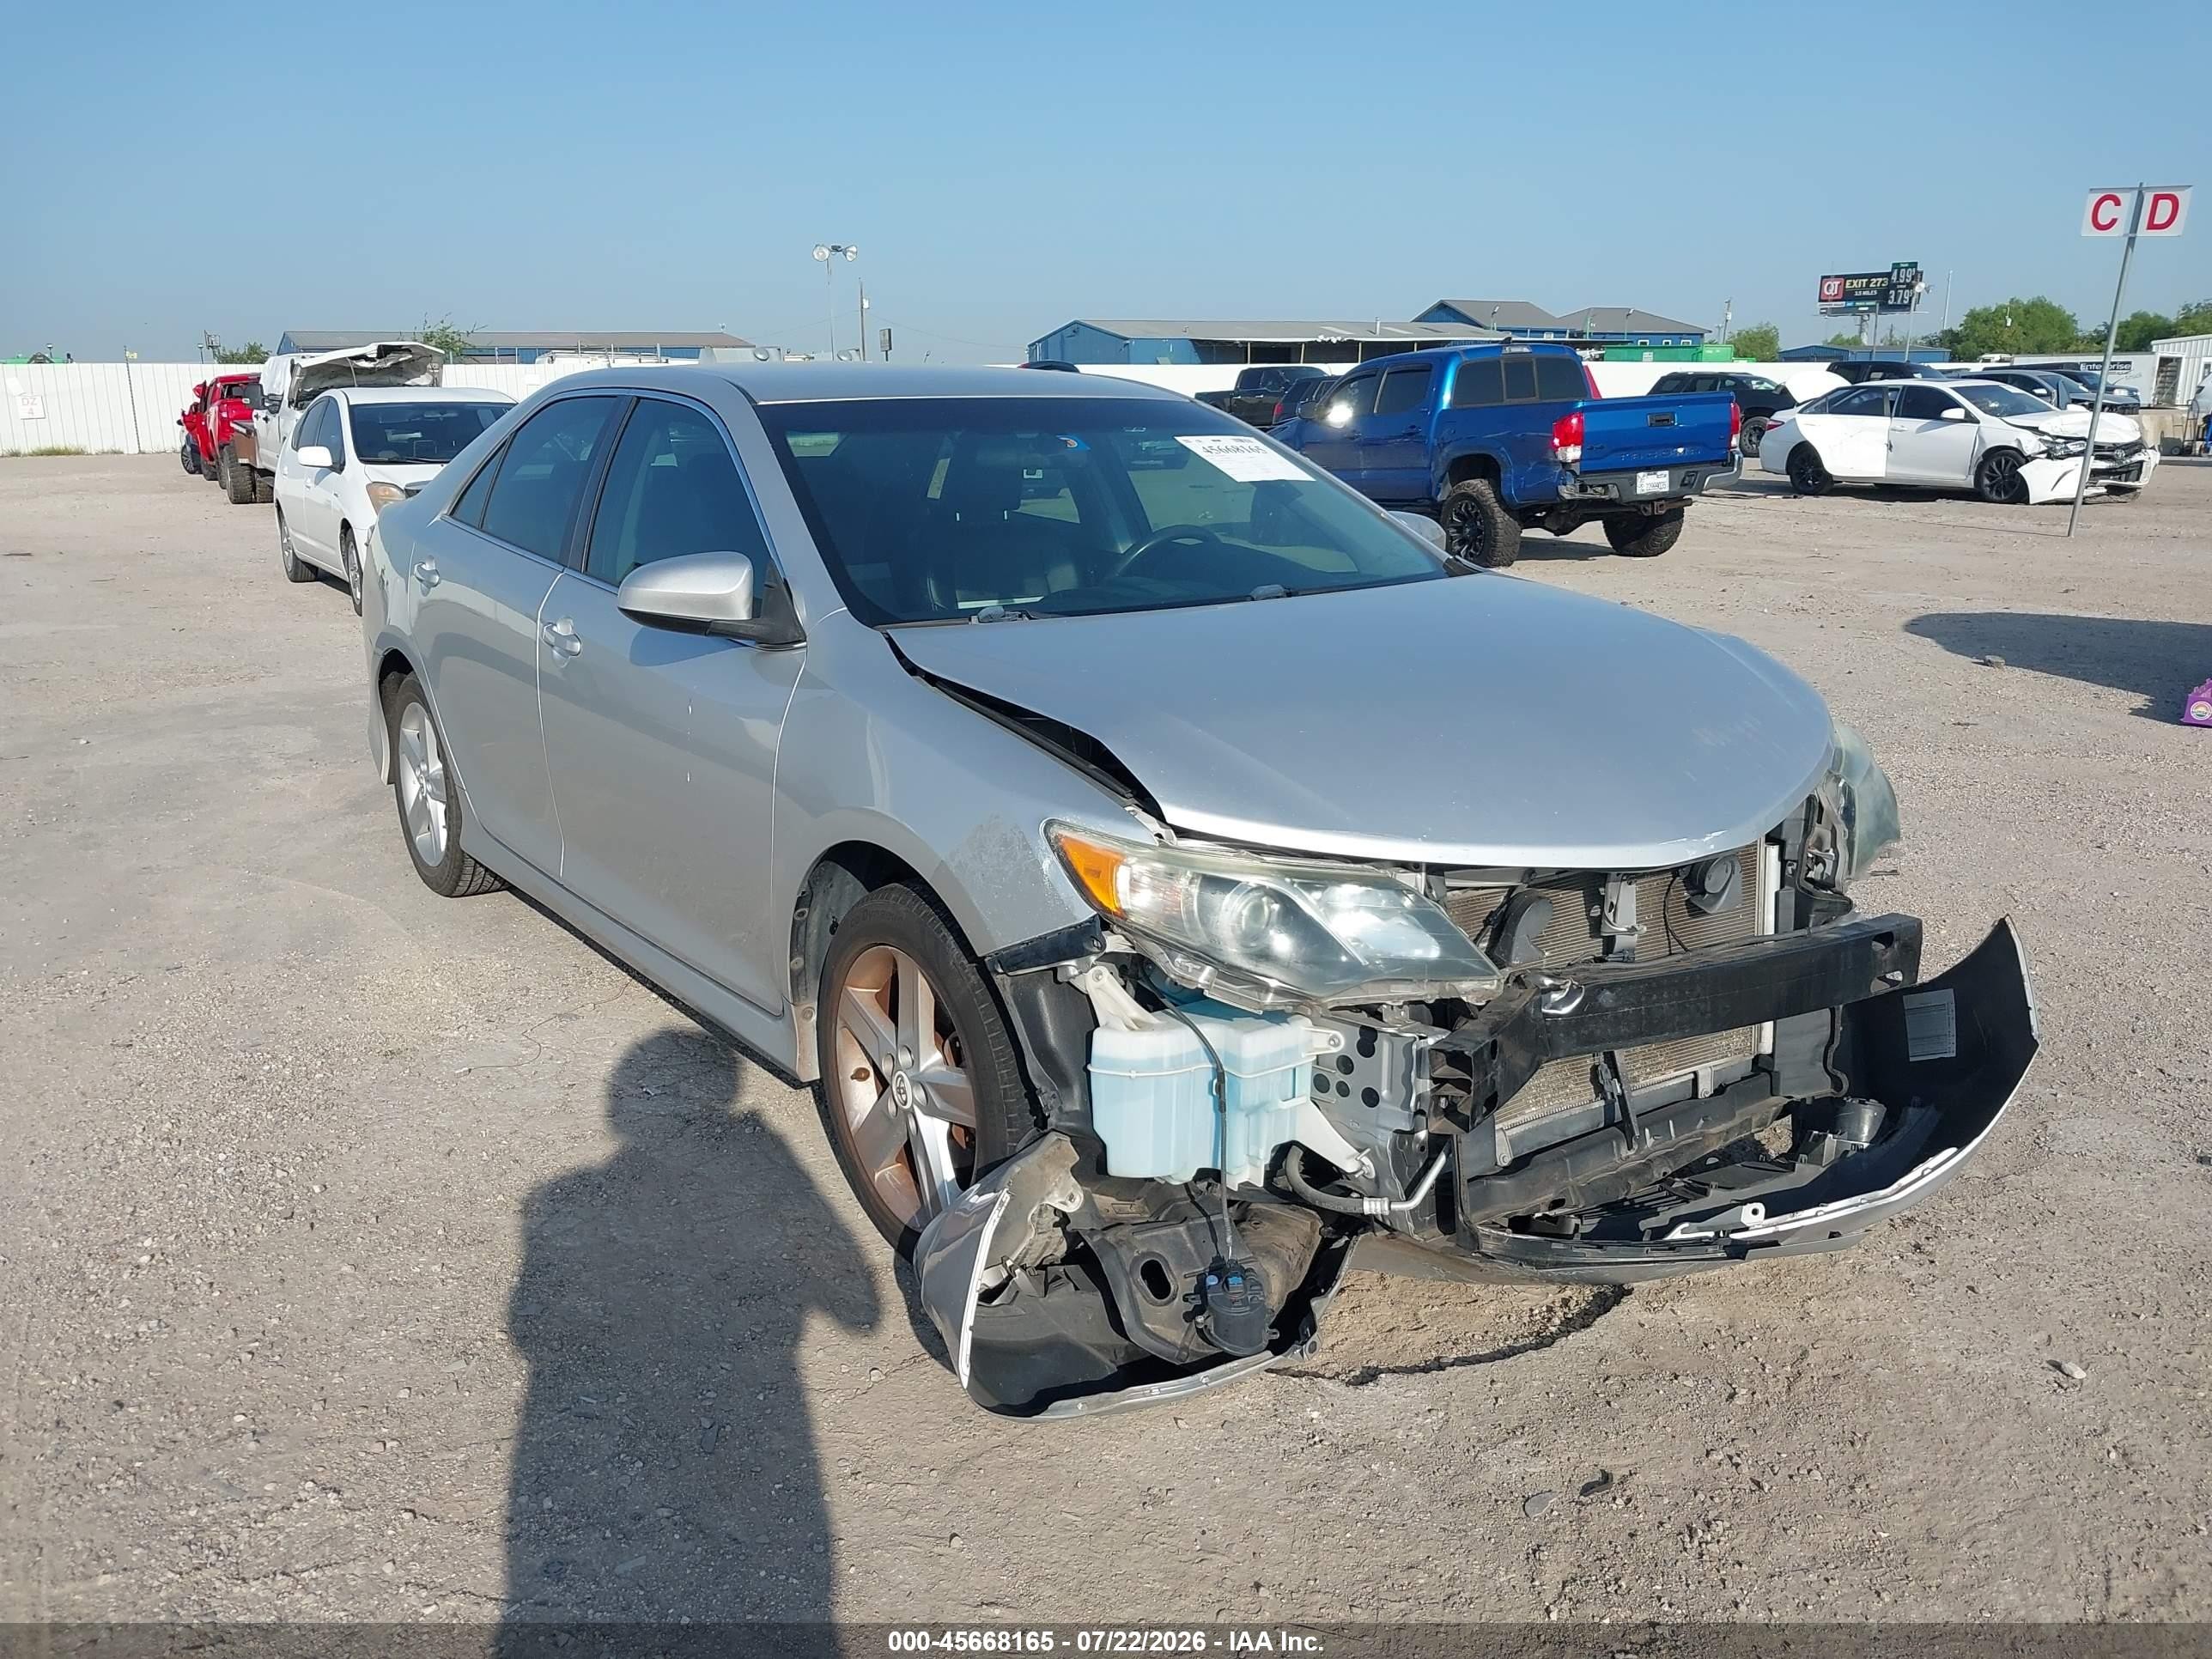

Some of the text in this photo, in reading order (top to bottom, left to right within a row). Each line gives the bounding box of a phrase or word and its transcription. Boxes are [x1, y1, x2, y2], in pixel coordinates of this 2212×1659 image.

[2091, 193, 2122, 231] C
[2146, 193, 2179, 230] D
[1823, 281, 1841, 295] QT
[1845, 279, 1869, 289] EXIT
[1869, 277, 1889, 288] 273
[1201, 445, 1268, 455] 45668165
